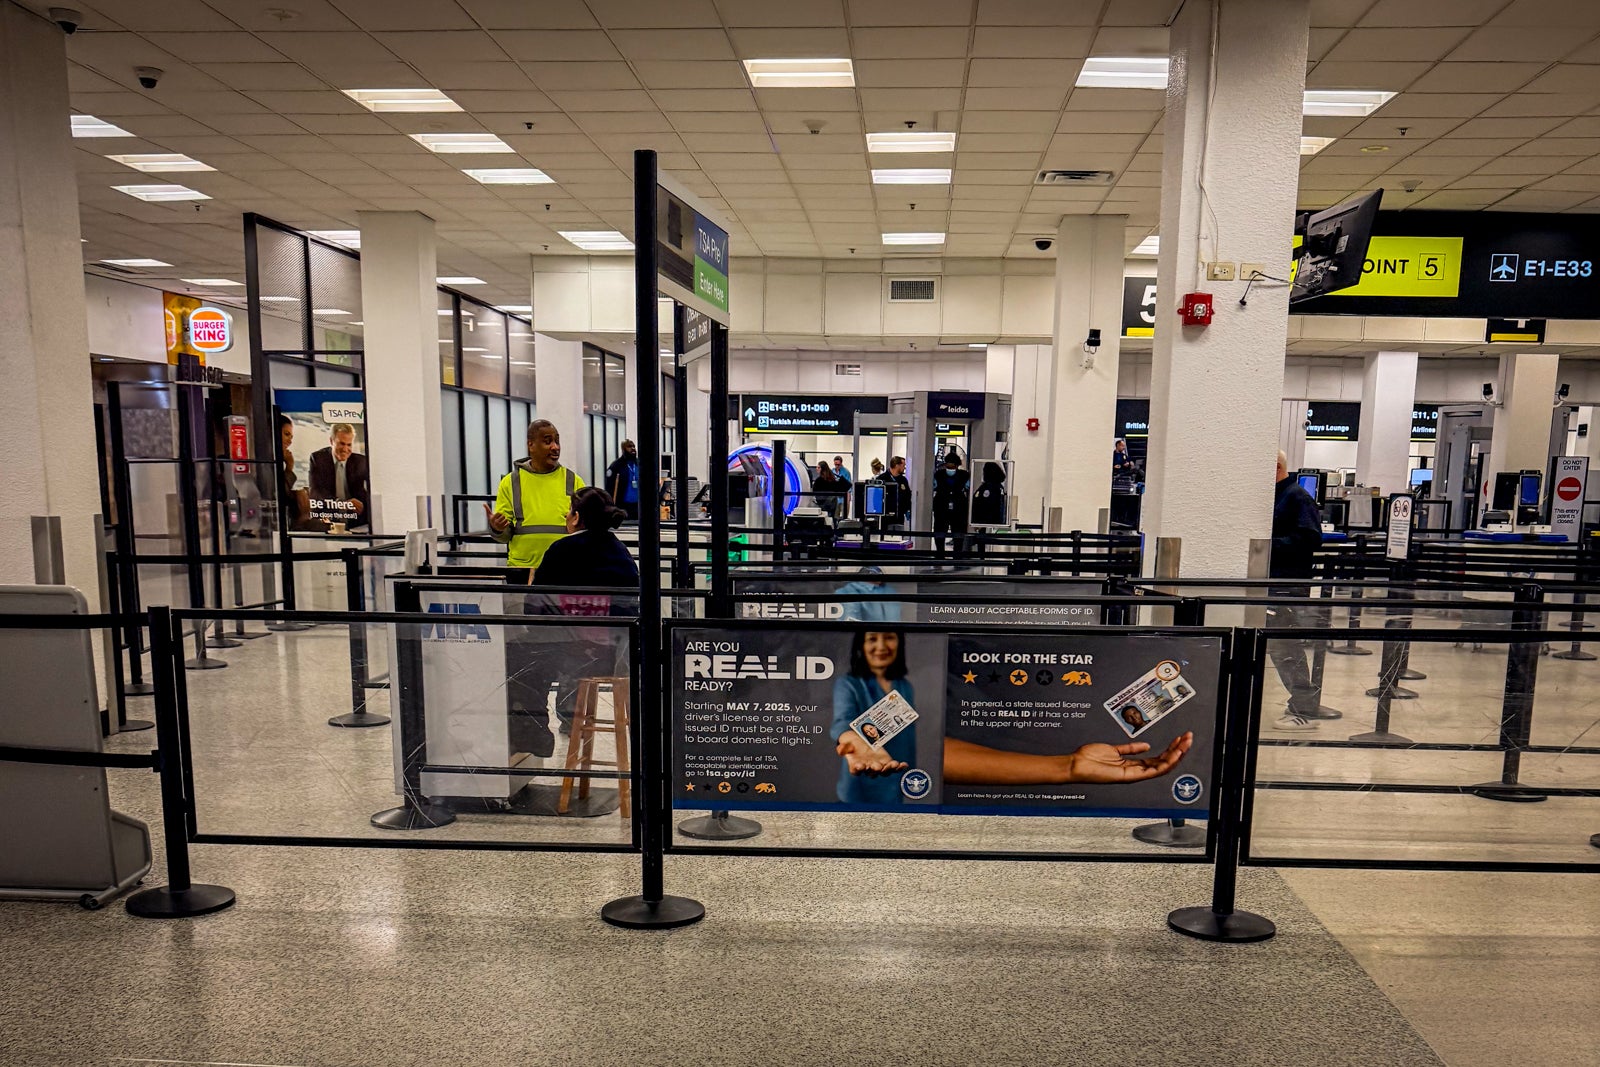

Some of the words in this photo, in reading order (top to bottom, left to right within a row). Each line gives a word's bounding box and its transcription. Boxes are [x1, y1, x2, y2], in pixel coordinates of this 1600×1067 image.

[698, 228, 711, 256] TSA
[1425, 258, 1438, 276] 5
[1524, 260, 1593, 277] E1-E33
[700, 272, 713, 296] Enter
[193, 321, 226, 329] BURGER
[194, 330, 226, 341] KING
[607, 403, 624, 411] NOT
[769, 403, 799, 412] E1-E11,
[801, 404, 829, 412] D1-D60
[948, 405, 969, 413] leidos
[328, 410, 342, 418] TSA
[816, 419, 839, 427] Lounge
[1326, 424, 1350, 433] Lounge
[310, 499, 323, 509] Be
[325, 499, 356, 510] There.
[742, 602, 814, 618] REAL
[818, 602, 844, 619] ID
[987, 607, 1038, 615] ACCEPTABLE
[685, 642, 710, 652] ARE
[713, 642, 740, 653] YOU
[962, 653, 1001, 663] LOOK
[1004, 653, 1031, 664] FOR
[1033, 654, 1057, 664] THE
[1060, 654, 1093, 665] STAR
[685, 654, 791, 679] REAL
[796, 656, 835, 680] ID
[685, 681, 733, 691] READY?
[685, 701, 723, 712] Starting
[726, 702, 750, 711] MAY
[753, 703, 762, 712] 7,
[795, 704, 818, 713] your
[961, 699, 970, 707] In
[1013, 700, 1033, 708] state
[1062, 701, 1092, 709] license
[685, 713, 720, 722] driver's
[723, 713, 759, 722] license
[762, 714, 773, 722] or
[775, 713, 801, 723] state
[998, 710, 1019, 718] REAL
[1021, 710, 1031, 718] ID
[1071, 711, 1086, 719] star
[684, 723, 717, 733] issued
[720, 724, 729, 733] ID
[732, 724, 757, 733] must
[759, 724, 774, 733] be
[776, 726, 783, 734] a
[786, 725, 810, 734] REAL
[812, 725, 823, 734] ID
[970, 719, 984, 727] the
[986, 720, 1011, 728] upper
[1013, 720, 1032, 728] right
[1033, 720, 1062, 728] corner.
[684, 735, 694, 743] to
[697, 734, 729, 744] board
[731, 735, 779, 745] domestic
[781, 736, 813, 746] flights.
[706, 754, 741, 763] complete
[685, 762, 727, 770] acceptable
[706, 770, 756, 778] tsa.gov/id
